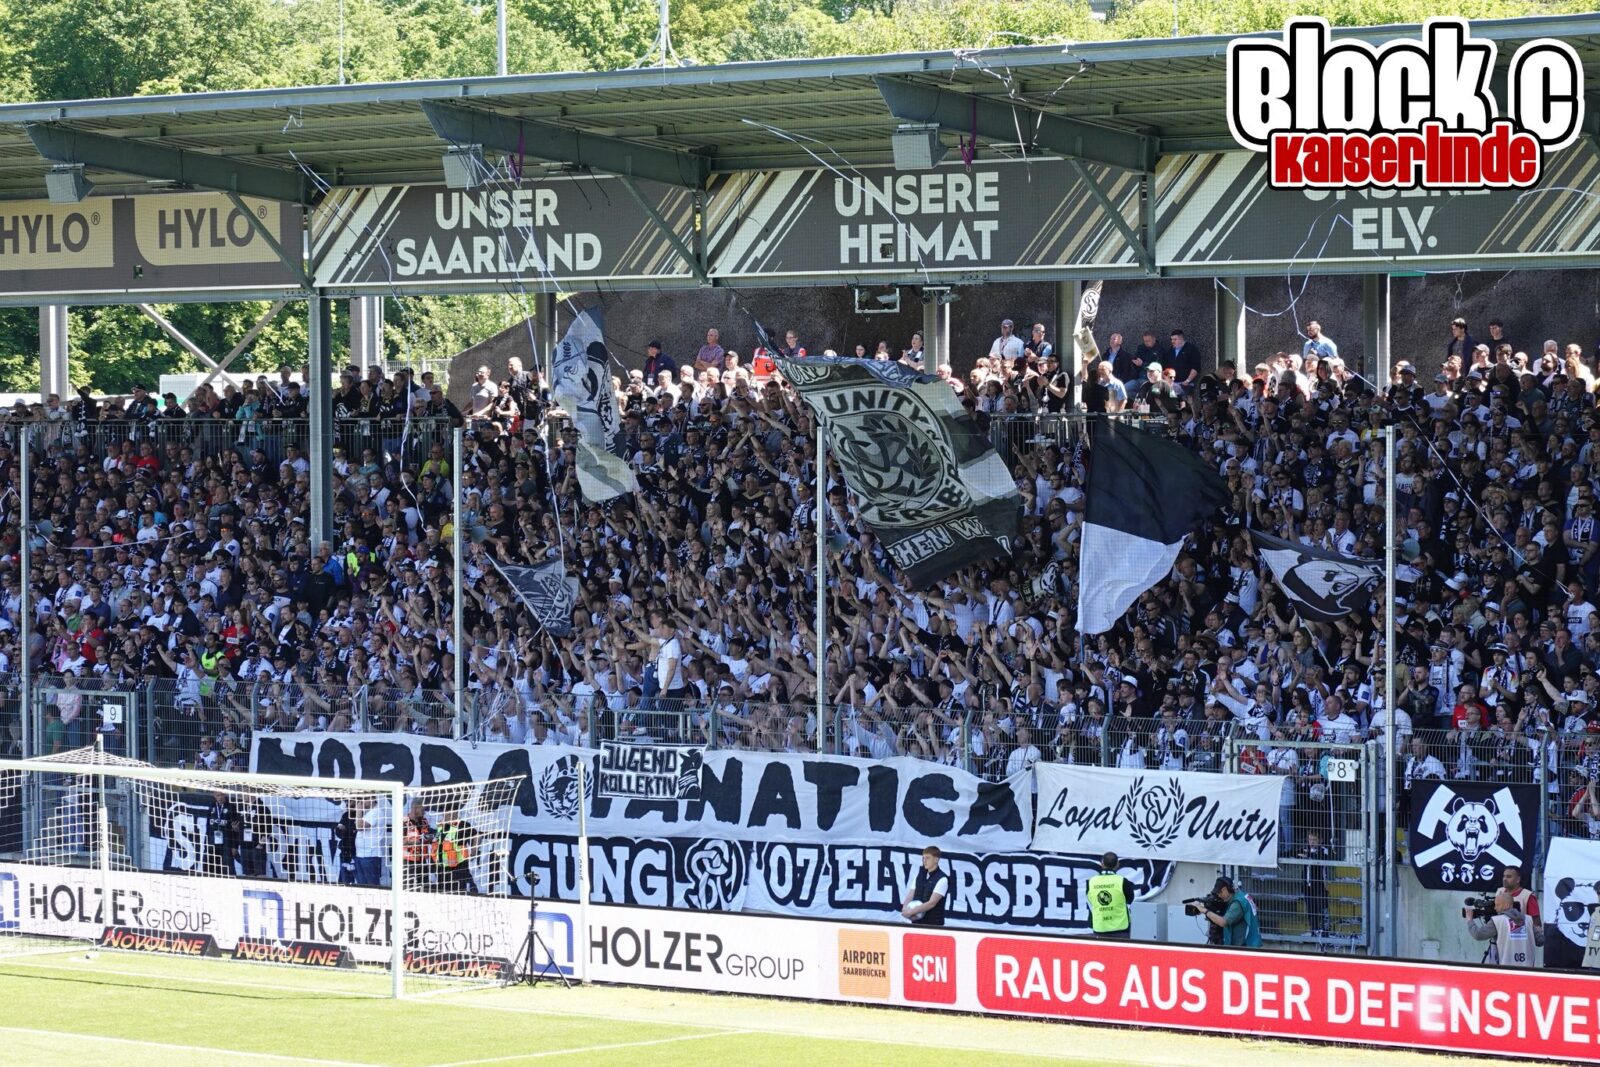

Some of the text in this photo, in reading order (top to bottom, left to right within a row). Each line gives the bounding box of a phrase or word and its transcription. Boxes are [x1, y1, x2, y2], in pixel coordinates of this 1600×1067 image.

[435, 188, 560, 230] UNSER
[835, 171, 999, 217] UNSERE
[840, 220, 998, 264] HEIMAT
[1352, 206, 1438, 254] ELV.
[396, 232, 602, 276] SAARLAND
[823, 390, 929, 424] UNITY
[110, 706, 117, 721] 9
[602, 745, 678, 774] JUGEND
[1337, 761, 1347, 778] 8
[600, 771, 678, 797] KOLLEKTIV
[1038, 787, 1276, 855] Loyal Unity
[29, 884, 212, 932] HOLZER GROUP
[422, 929, 495, 955] GROUP
[590, 925, 804, 981] HOLZER GROUP
[842, 949, 886, 966] AIRPORT
[842, 966, 887, 979] SAARBRÜCKEN
[912, 955, 948, 983] SCN
[995, 954, 1107, 1005] RAUS
[1119, 964, 1207, 1012] AUS
[1222, 971, 1311, 1021] DER
